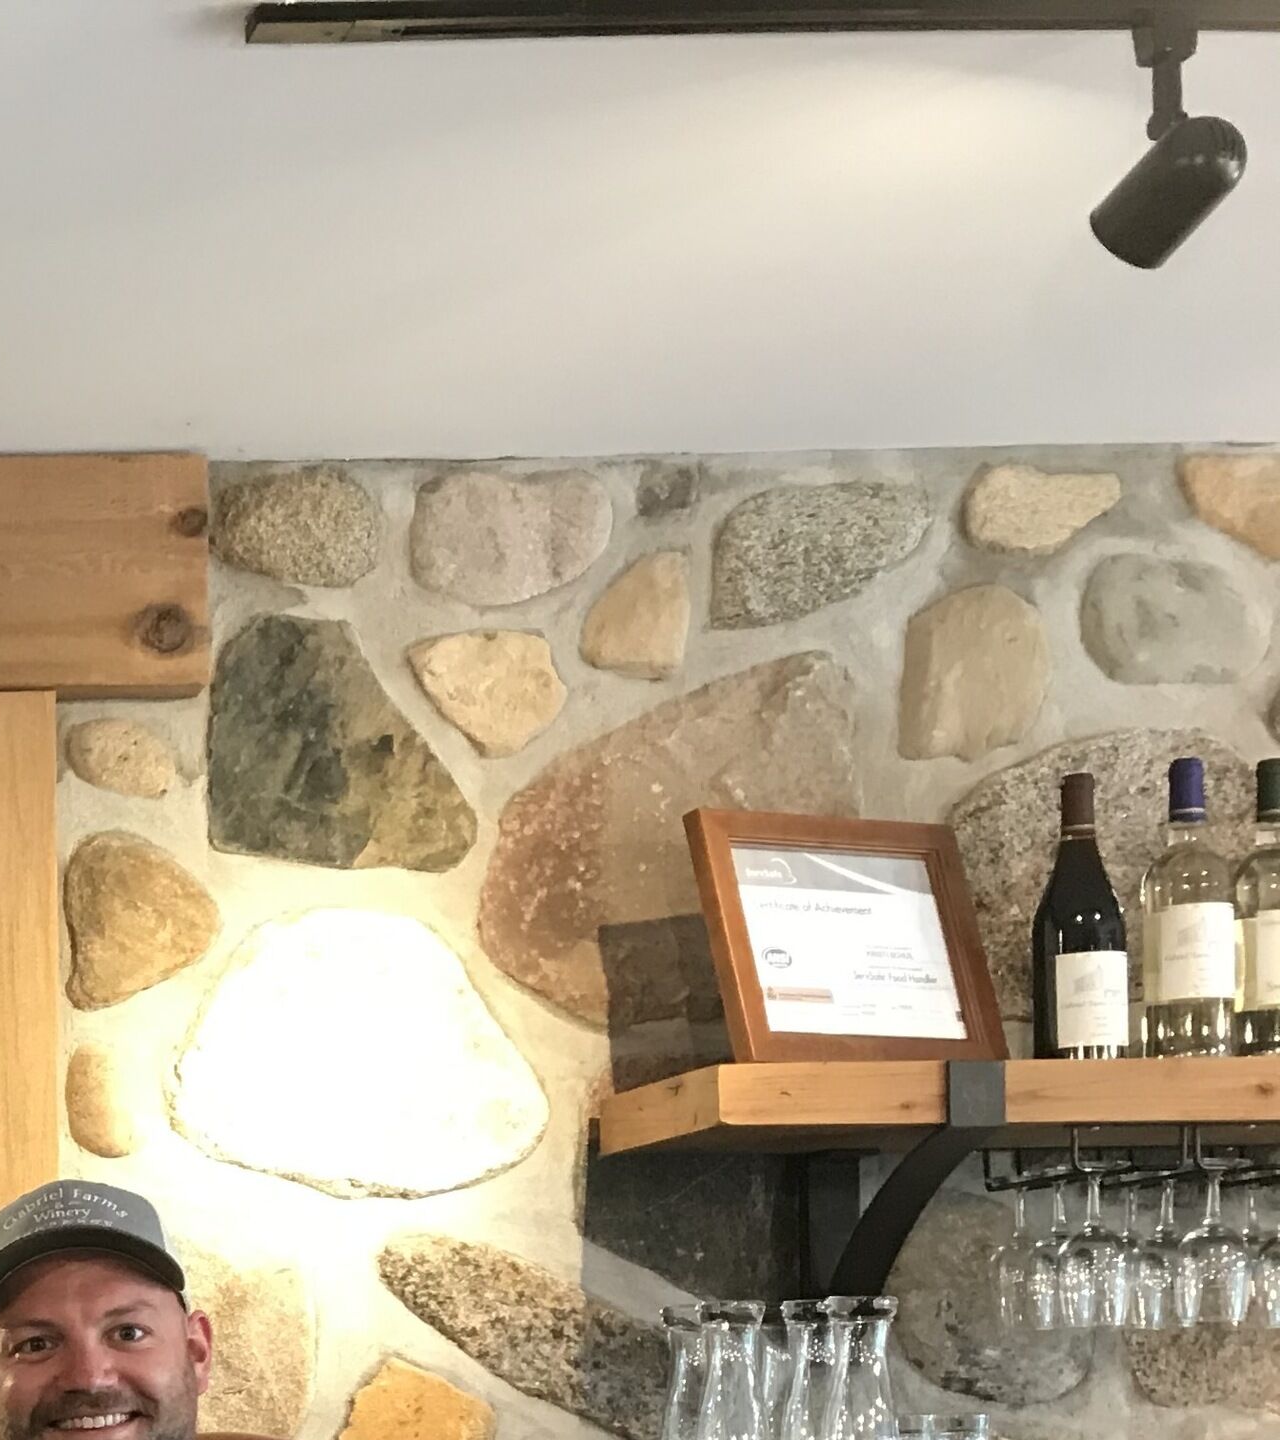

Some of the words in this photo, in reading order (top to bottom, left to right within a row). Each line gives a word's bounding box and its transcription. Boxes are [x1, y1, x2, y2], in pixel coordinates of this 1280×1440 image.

[2, 1187, 64, 1230] Gabriel
[72, 1188, 129, 1218] Farms
[33, 1207, 92, 1223] Winery
